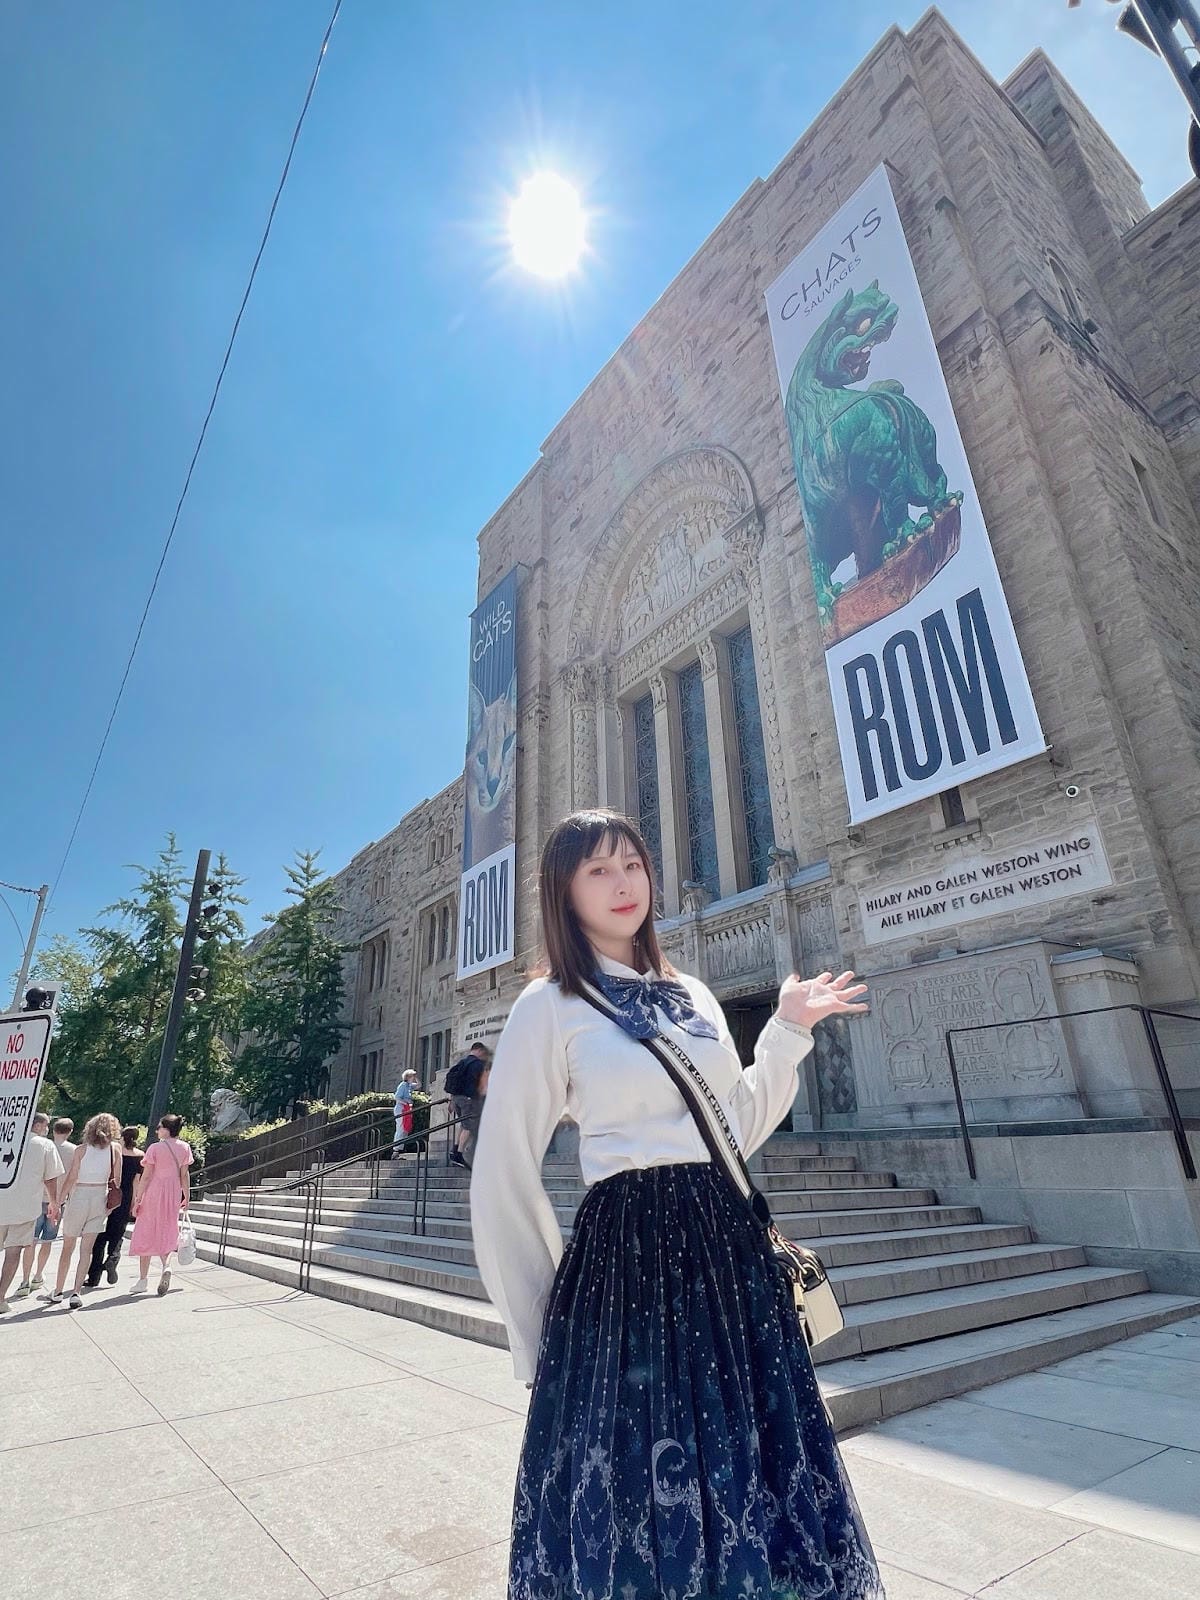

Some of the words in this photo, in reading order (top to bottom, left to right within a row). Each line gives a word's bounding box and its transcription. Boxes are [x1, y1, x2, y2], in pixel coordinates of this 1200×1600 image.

[780, 207, 882, 320] CHATS
[803, 255, 862, 317] SAUVAGES
[480, 600, 505, 634] WILD
[472, 610, 512, 662] CATS
[842, 587, 1019, 802] ROM
[866, 892, 902, 911] HILARY
[907, 885, 932, 900] AND
[935, 870, 978, 891] GALEN
[981, 852, 1040, 878] WESTON
[1044, 837, 1091, 859] WING
[881, 913, 903, 928] AILE
[907, 901, 946, 921] HILARY
[951, 896, 965, 910] ET
[969, 883, 1014, 904] GALEN
[1018, 864, 1082, 891] WESTON
[463, 859, 508, 968] ROM
[925, 987, 947, 1005] THE
[951, 983, 981, 1001] ARTS
[936, 1005, 948, 1020] OF
[951, 1001, 977, 1018] MAN
[6, 1033, 24, 1054] NO
[668, 1041, 691, 1067] MARC
[941, 1039, 964, 1056] AL
[962, 1036, 988, 1053] THE
[0, 1057, 39, 1080] NDING
[0, 1096, 29, 1117] NGER
[691, 1069, 729, 1128] SNAPSHOT
[725, 1128, 740, 1157] THE
